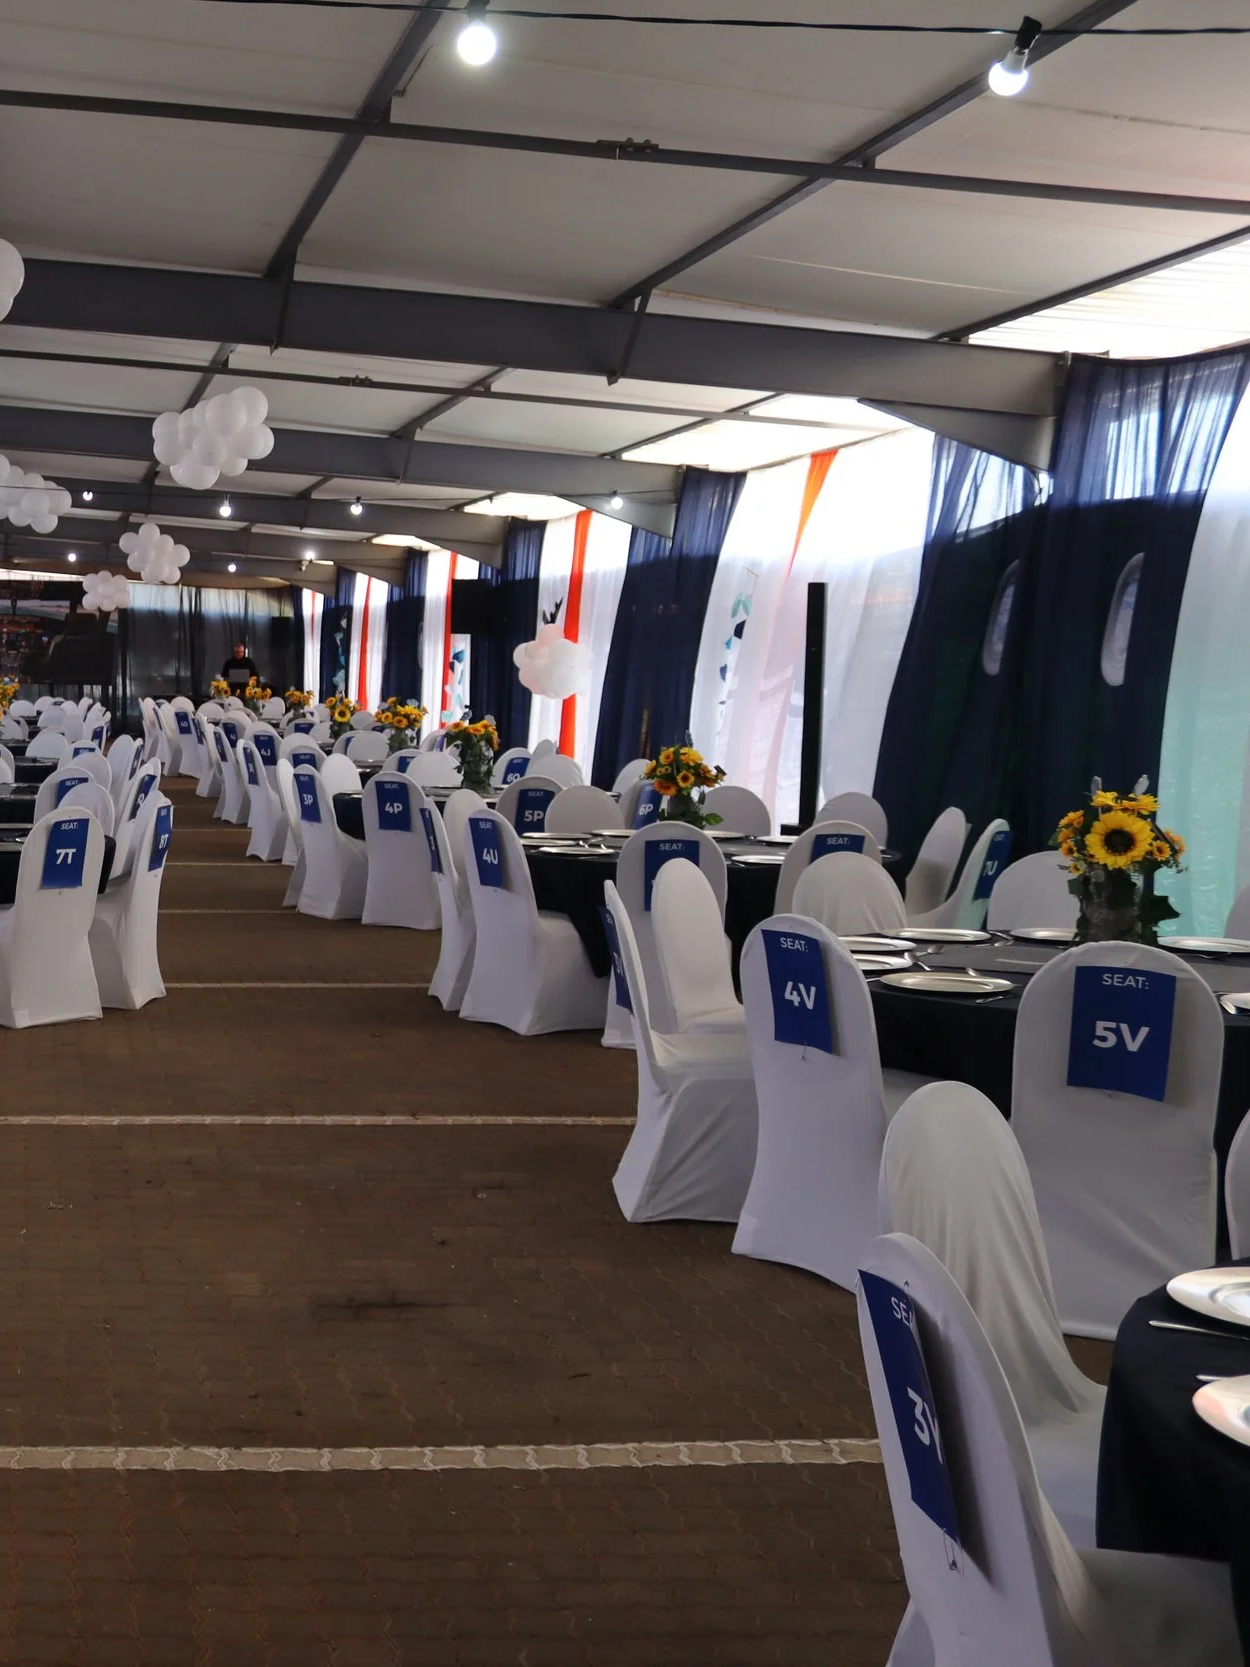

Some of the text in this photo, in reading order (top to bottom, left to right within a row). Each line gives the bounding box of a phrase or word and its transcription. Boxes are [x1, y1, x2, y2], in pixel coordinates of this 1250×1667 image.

[302, 793, 313, 806] 3P
[384, 802, 403, 815] 4P
[638, 803, 654, 816] 6P
[523, 810, 544, 822] 5P
[659, 843, 686, 851] SEAT:
[826, 836, 851, 846] SEAT:
[56, 848, 76, 865] 7T
[482, 847, 498, 865] 4U
[780, 937, 809, 952] SEAT:
[1101, 973, 1150, 990] SEAT:
[784, 981, 816, 1010] 4V
[1092, 1020, 1150, 1052] 5V
